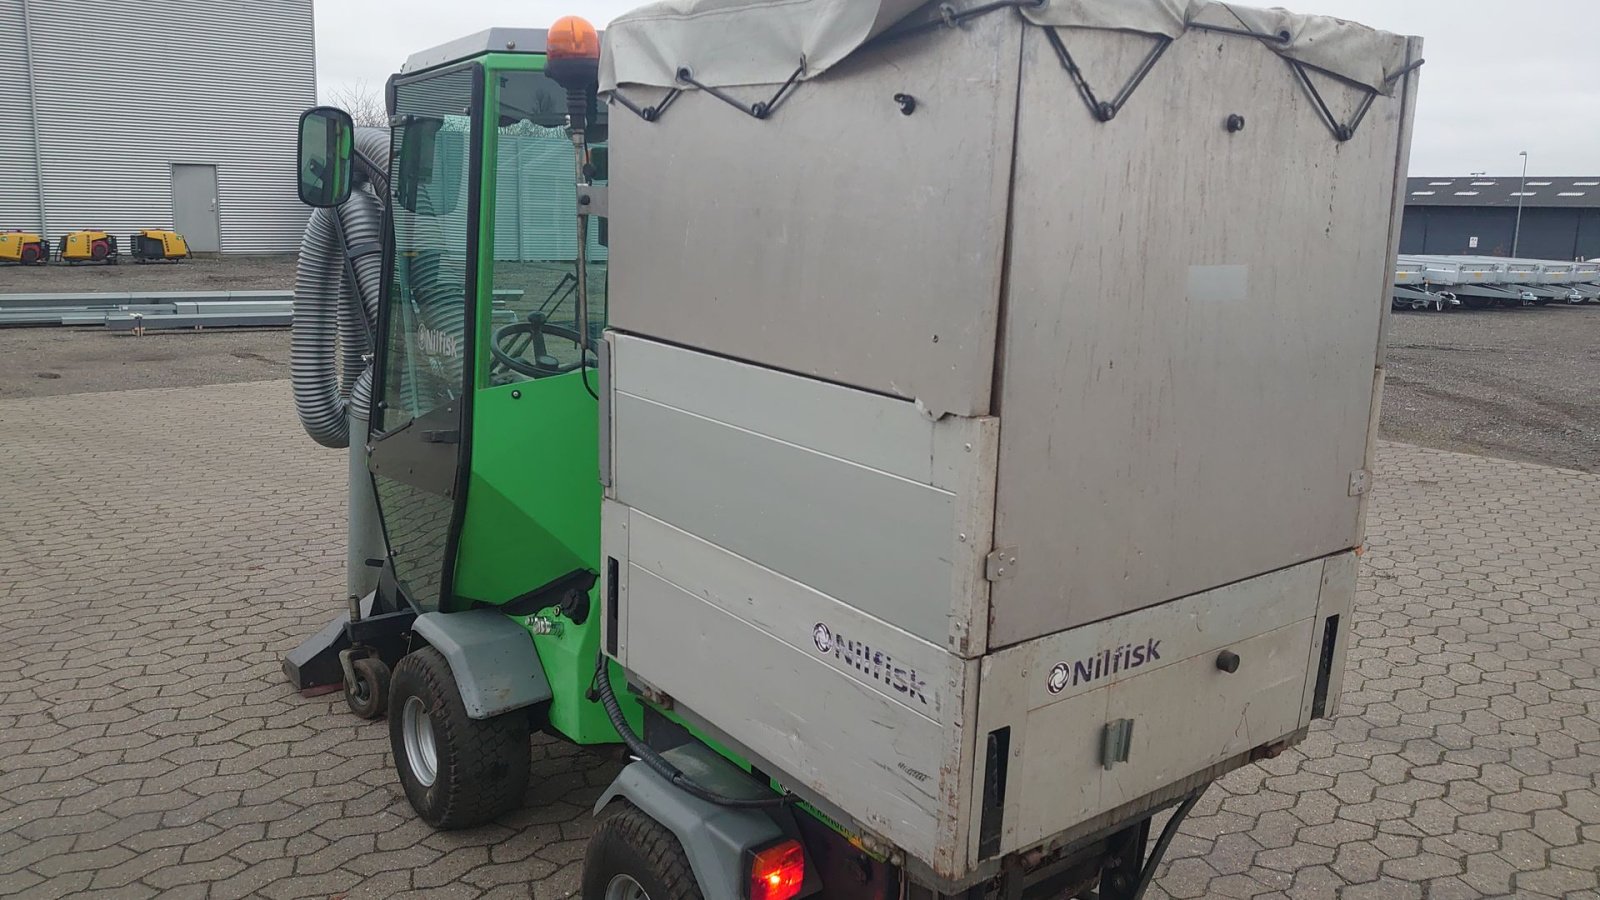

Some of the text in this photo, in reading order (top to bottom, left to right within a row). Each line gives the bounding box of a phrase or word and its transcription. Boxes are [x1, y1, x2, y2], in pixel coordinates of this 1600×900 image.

[426, 329, 457, 357] Nilfisk
[834, 634, 927, 704] Nilfisk
[1072, 638, 1162, 686] Nilfisk
